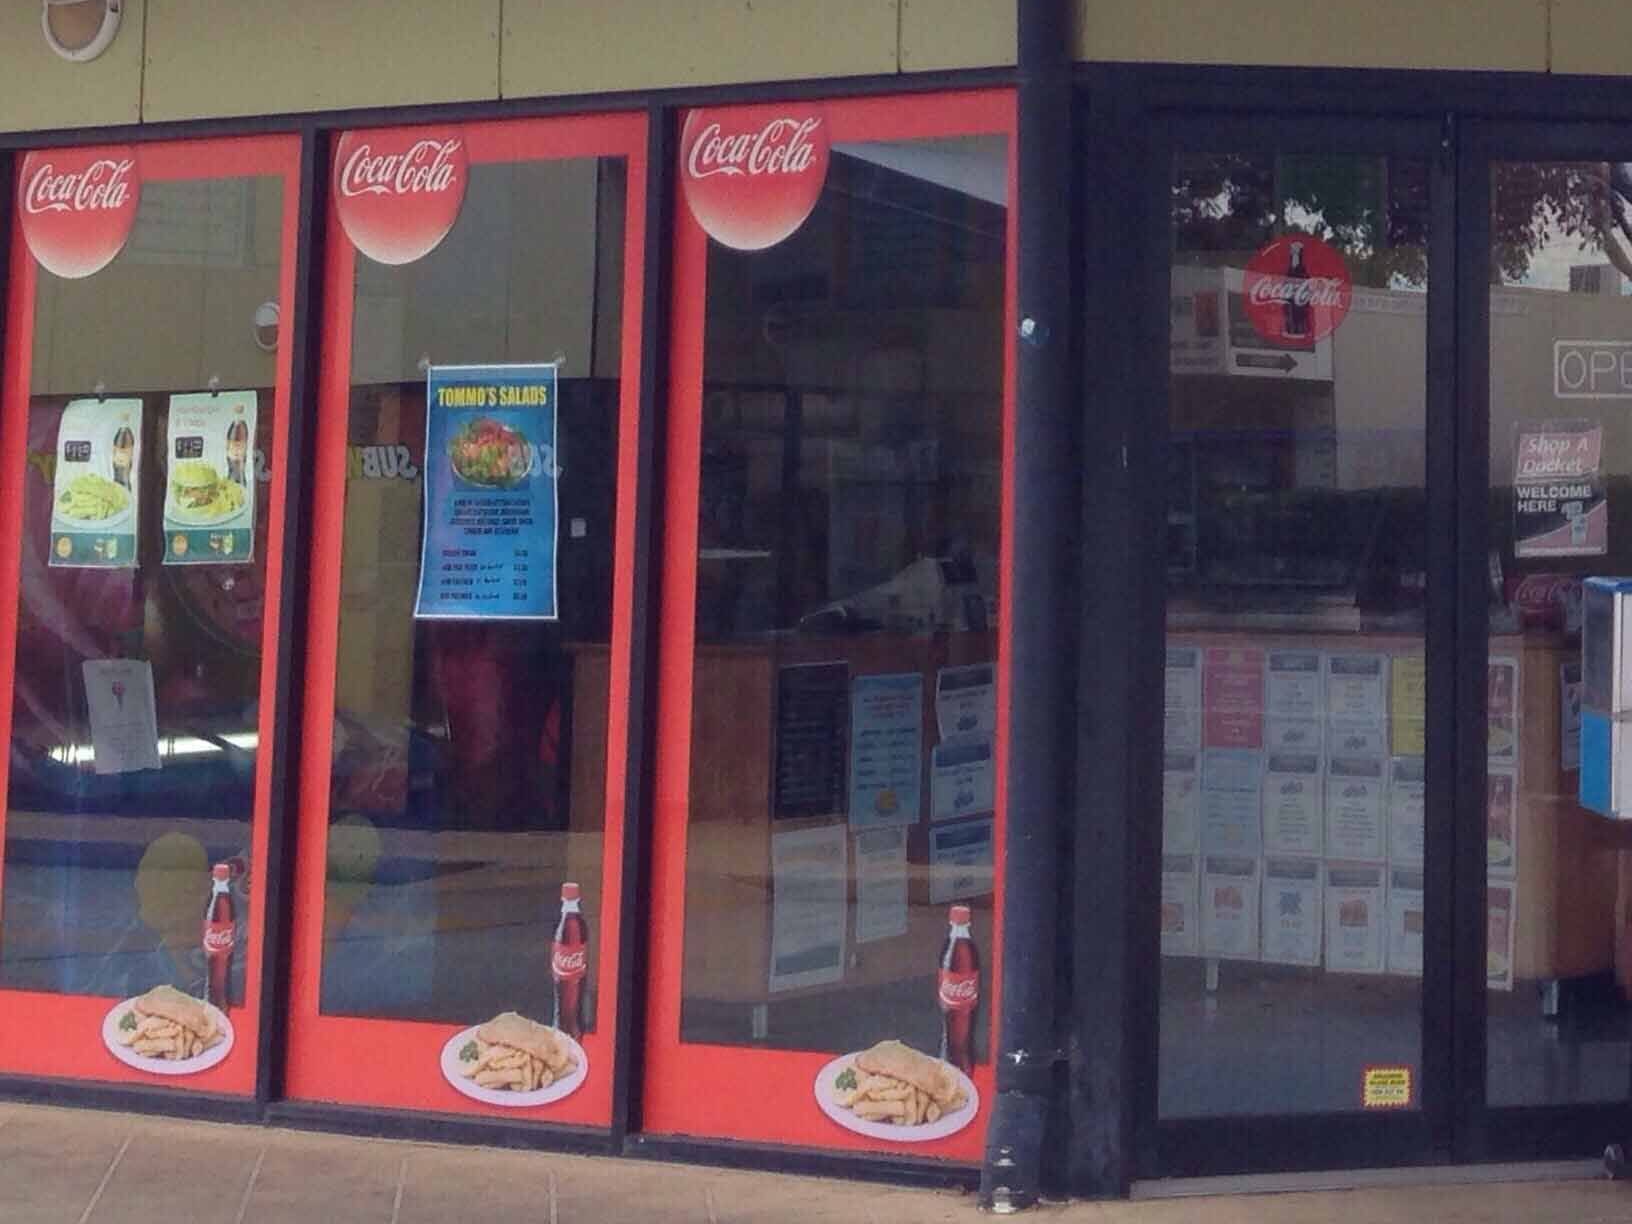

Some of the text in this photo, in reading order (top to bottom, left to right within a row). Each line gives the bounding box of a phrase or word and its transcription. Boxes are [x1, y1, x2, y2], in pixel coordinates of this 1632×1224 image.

[689, 116, 822, 178] Coca-Cola
[340, 137, 461, 196] Coca-Cola
[25, 159, 132, 214] Coca-Cola
[1250, 276, 1345, 309] Coca-Cola
[438, 384, 547, 408] TOMMO'S SALADS
[1527, 435, 1570, 458] Shop
[1516, 485, 1593, 499] WELCOME
[1517, 499, 1558, 513] HERE
